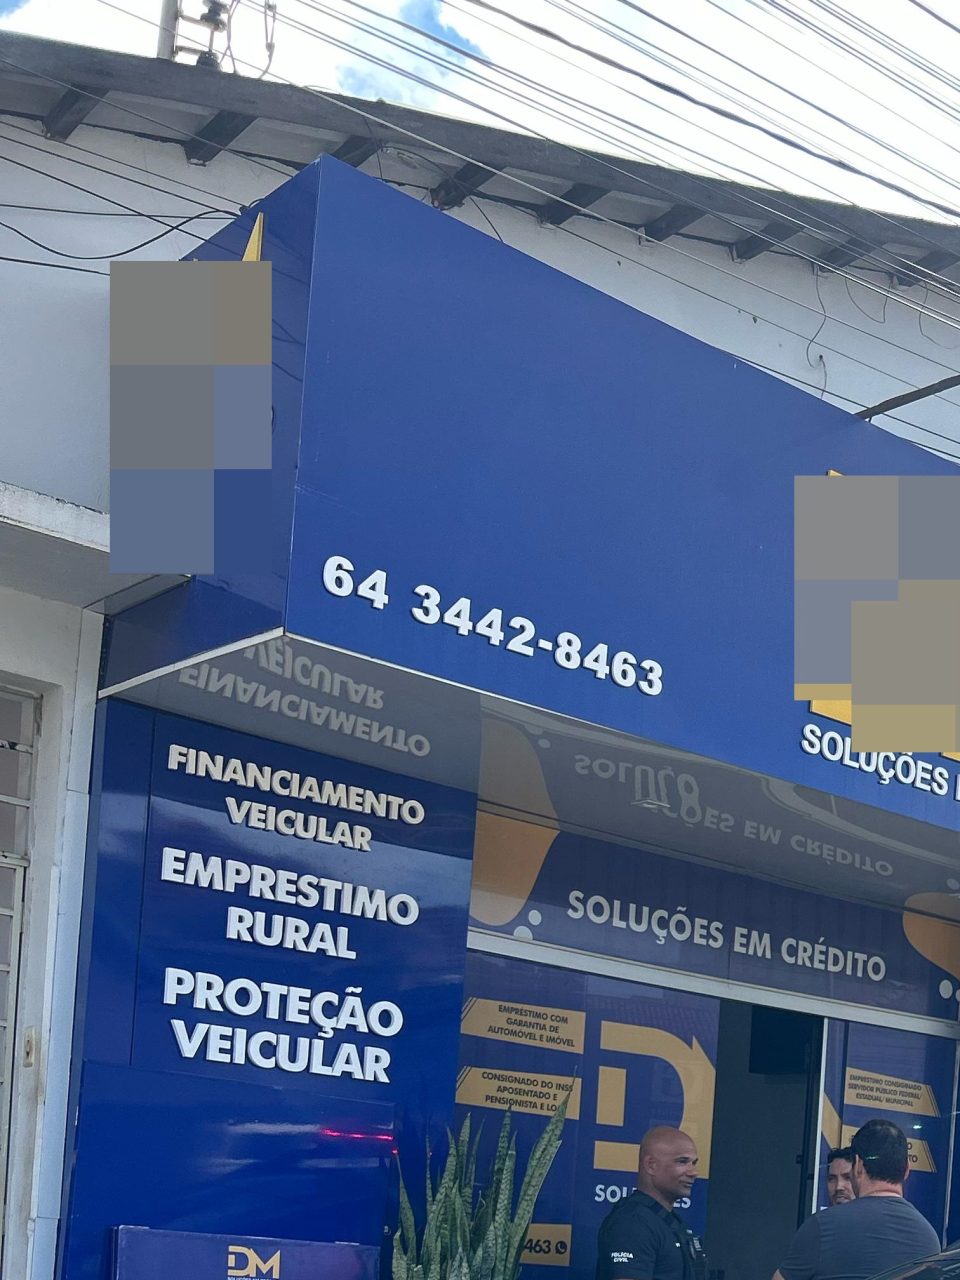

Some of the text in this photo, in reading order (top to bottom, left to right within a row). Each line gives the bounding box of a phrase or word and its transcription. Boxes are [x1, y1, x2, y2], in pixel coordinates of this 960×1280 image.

[322, 555, 663, 696] 64 3442-8463
[168, 744, 425, 825] FINANCIAMENTO
[226, 797, 373, 851] VEICULAR
[161, 847, 419, 926] EMPRESTIMO
[226, 906, 356, 959] RURAL
[567, 890, 887, 982] SOLUÇÕES EM CRÉDITO
[163, 966, 404, 1038] PROTEÇÃO
[506, 1017, 560, 1034] GARANTIA DE
[550, 1014, 568, 1025] COM
[170, 1019, 391, 1083] VEICULAR
[482, 1071, 539, 1087] CONSIGNADO
[541, 1080, 553, 1089] DO
[485, 1094, 538, 1109] PENSIONISTA
[497, 1085, 551, 1099] APOSENTADO
[228, 1245, 280, 1279] DM
